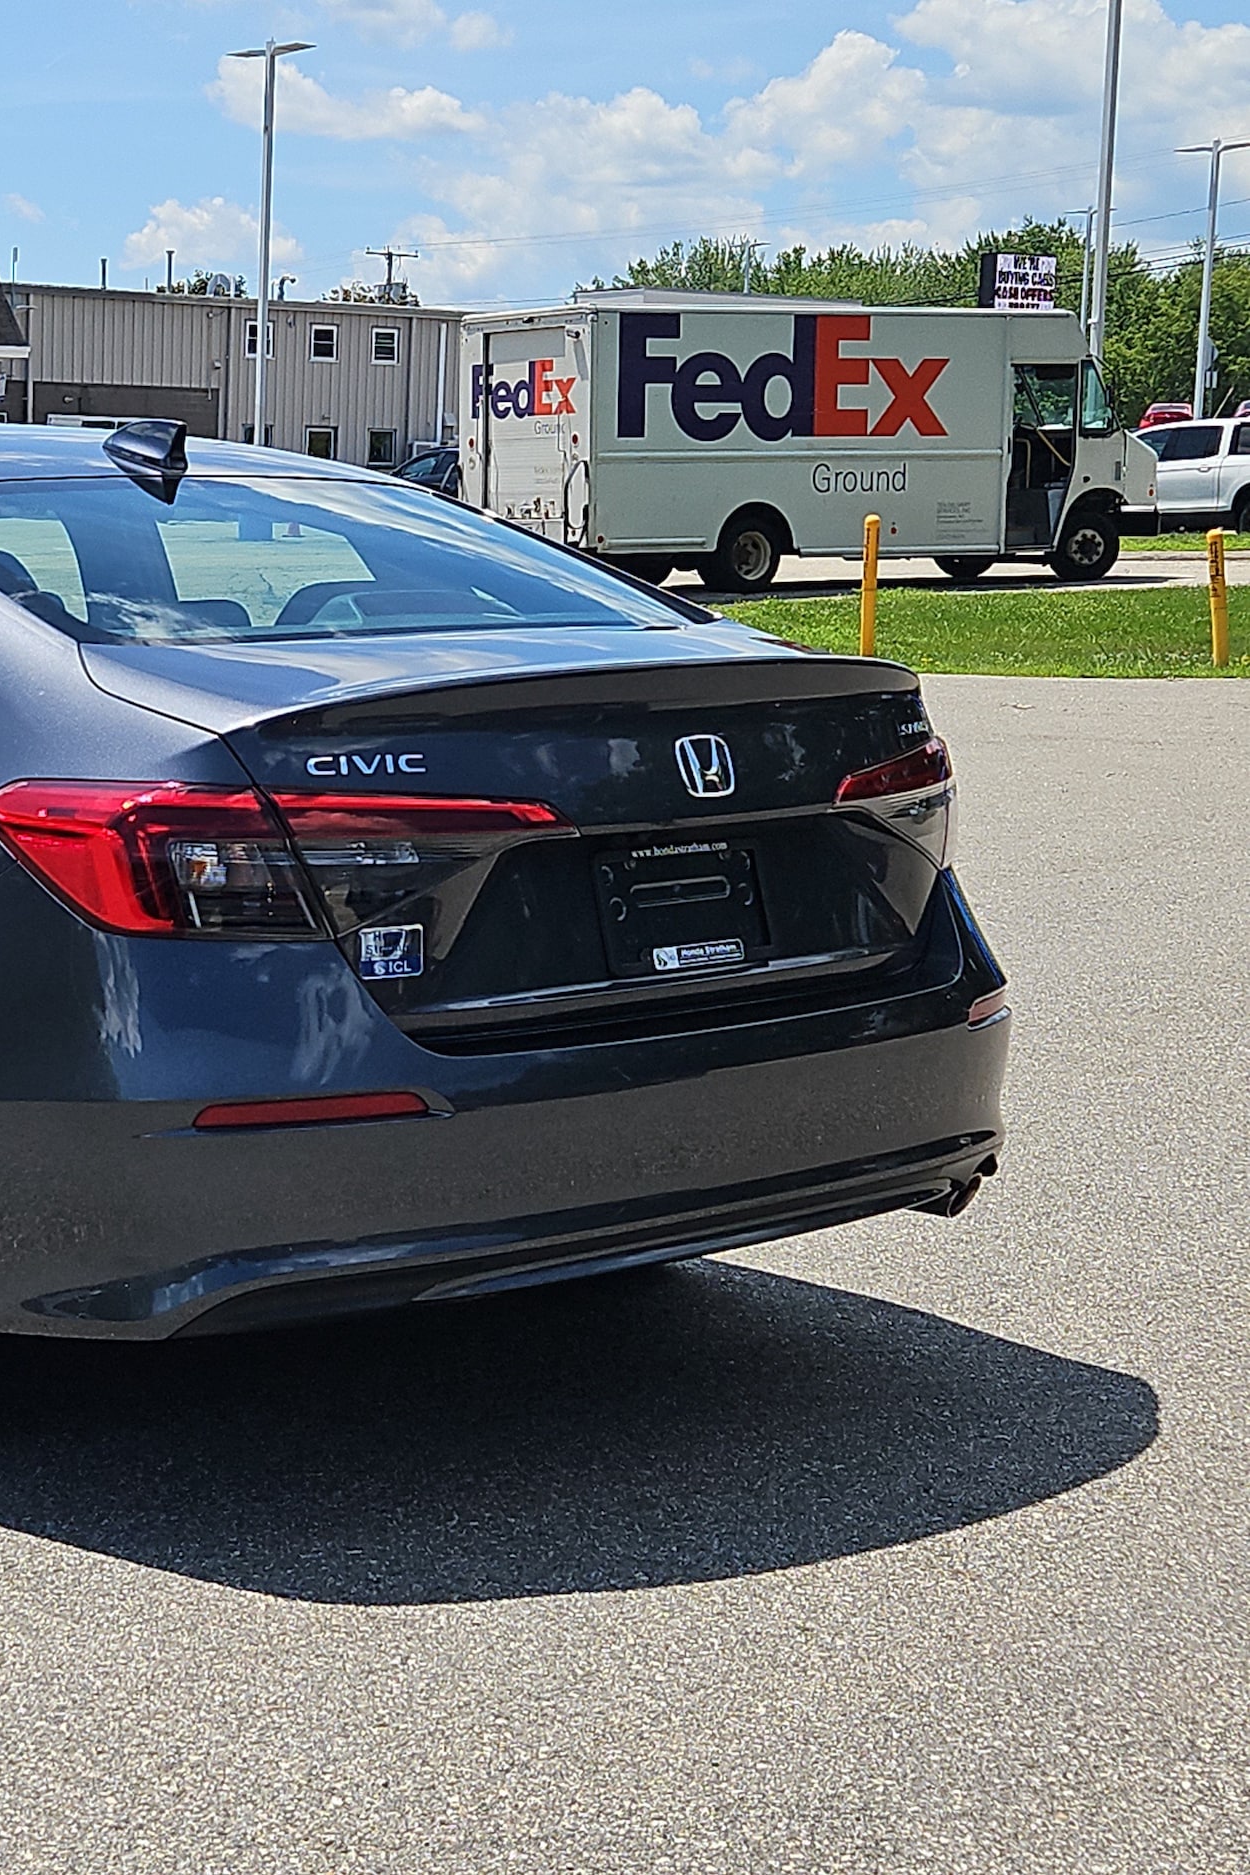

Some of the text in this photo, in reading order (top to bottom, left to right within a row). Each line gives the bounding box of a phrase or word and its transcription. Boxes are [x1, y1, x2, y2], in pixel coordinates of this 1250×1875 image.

[471, 359, 577, 420] FedEx
[617, 312, 950, 442] FedEx
[812, 462, 907, 493] Ground
[306, 754, 427, 776] CIVIC
